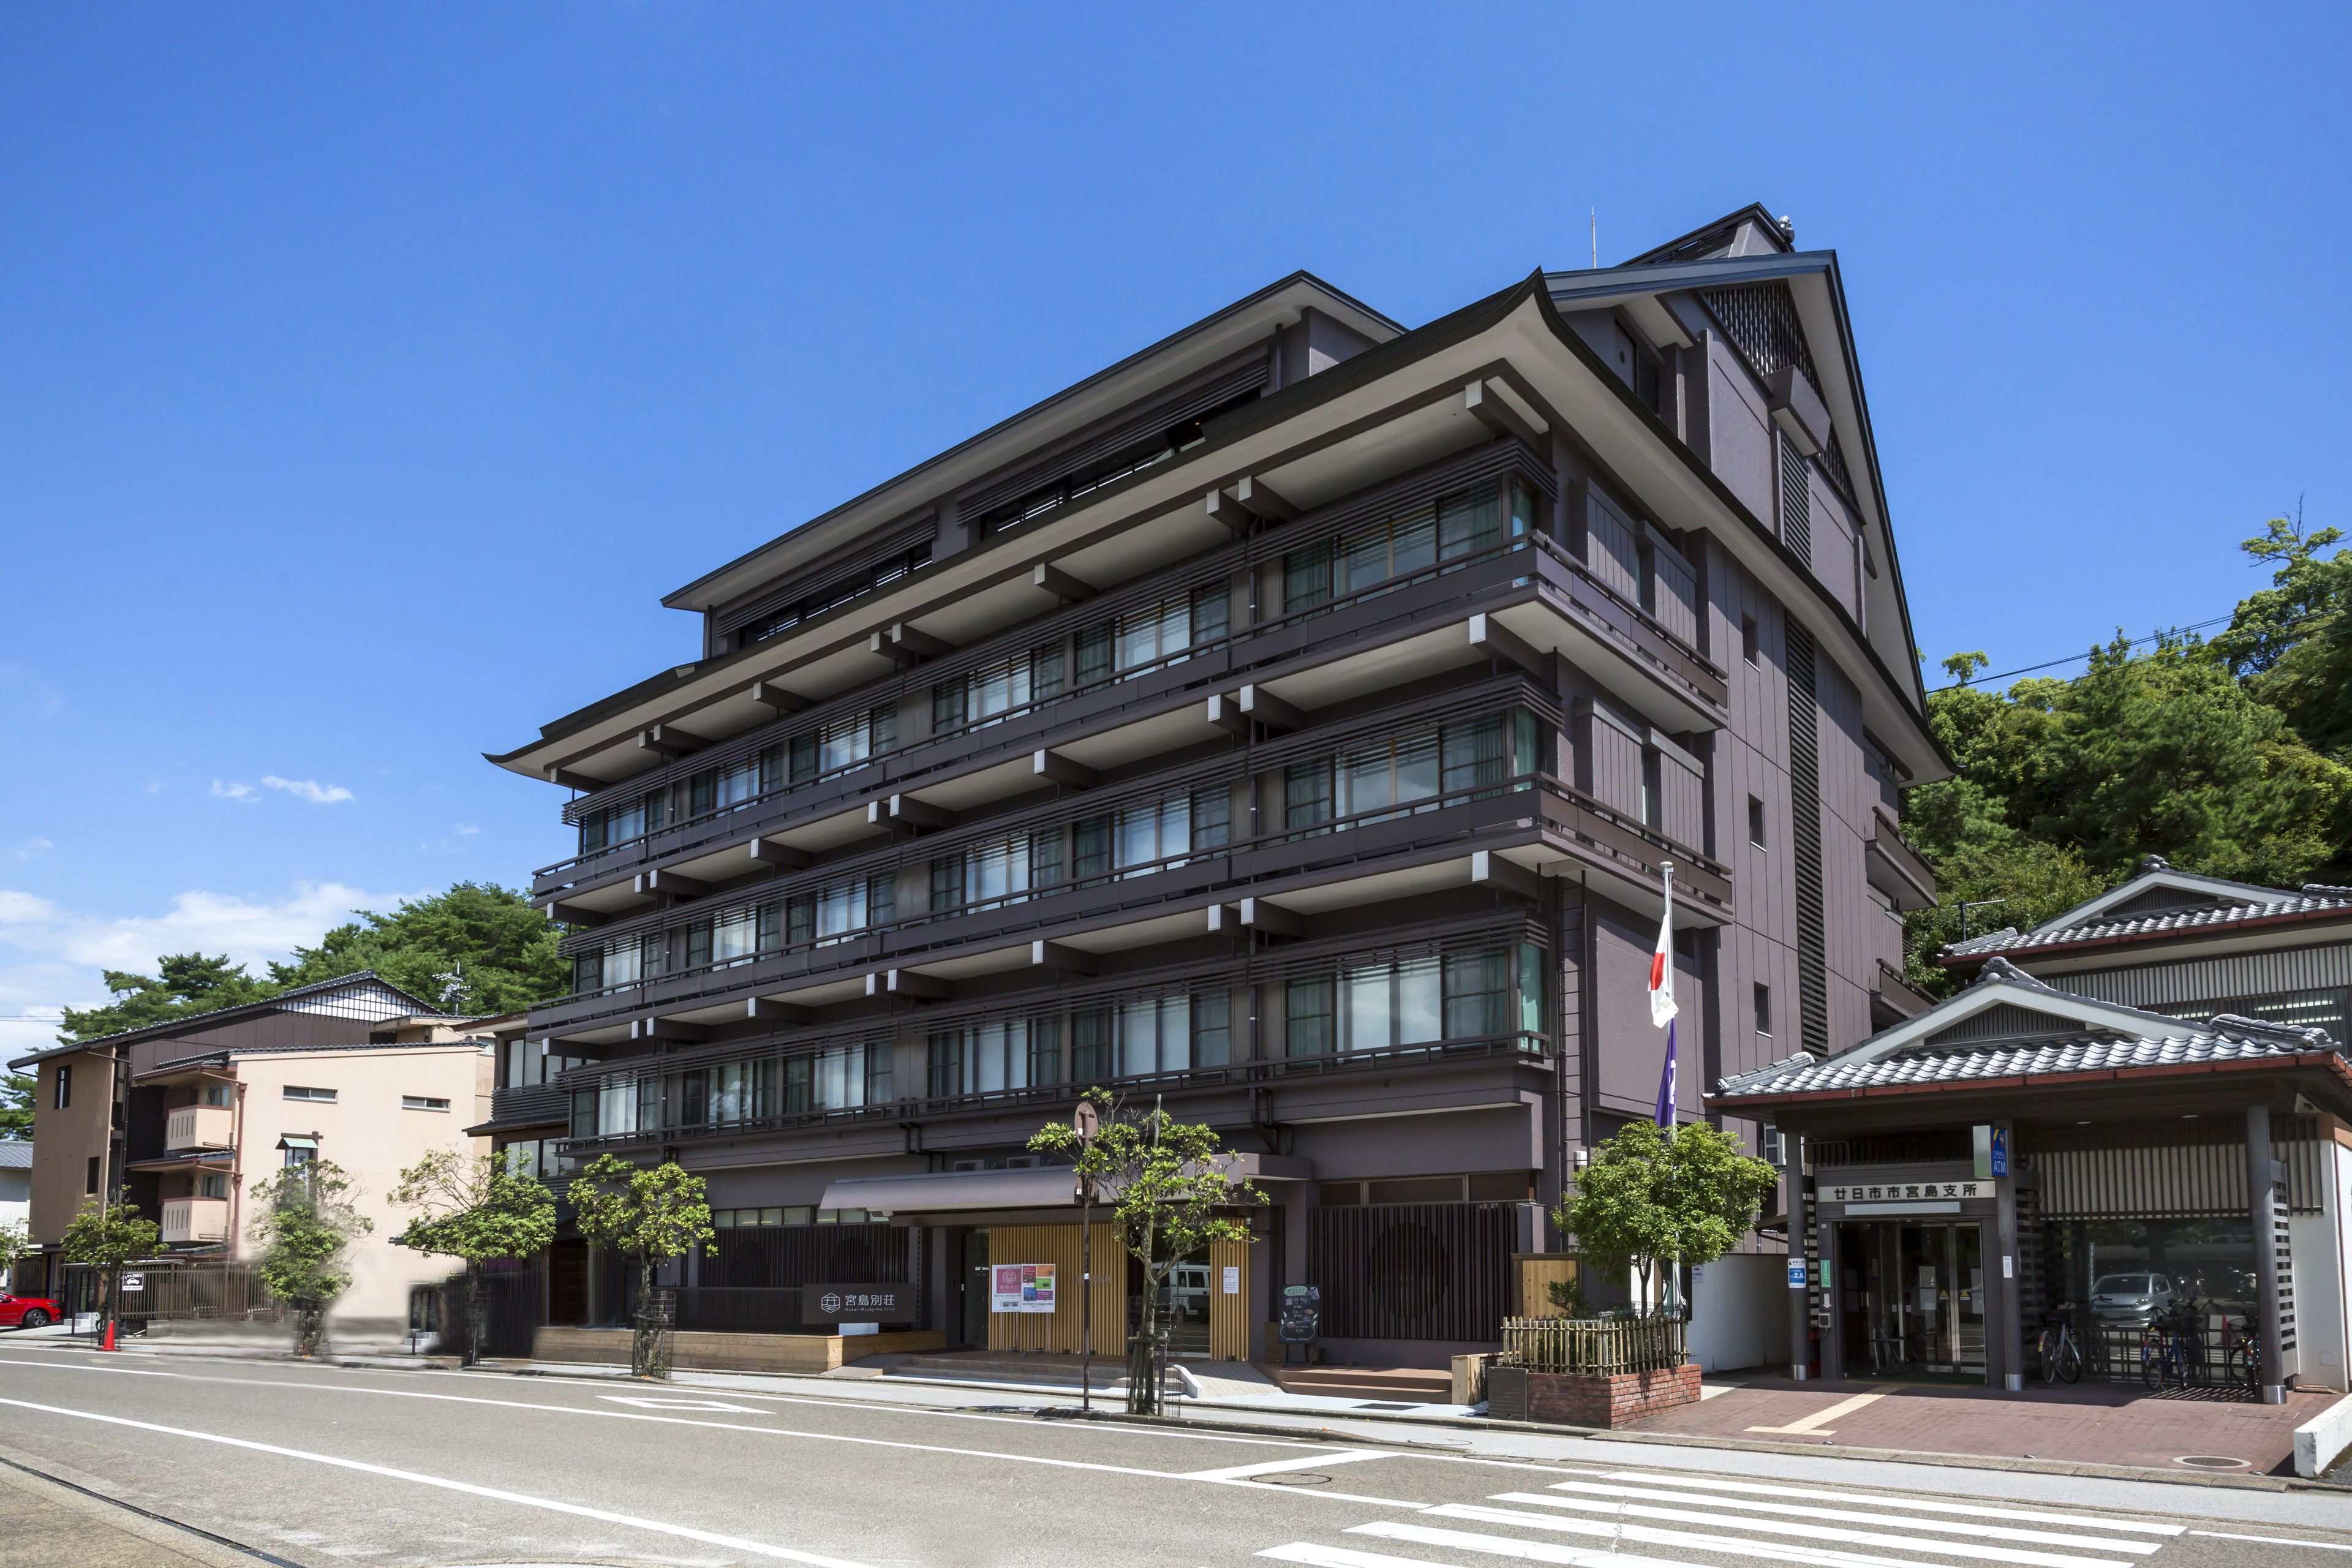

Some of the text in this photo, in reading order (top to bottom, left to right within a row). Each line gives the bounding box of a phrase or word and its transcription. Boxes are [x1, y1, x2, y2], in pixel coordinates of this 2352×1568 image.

[1994, 1160, 2007, 1173] ATM
[1834, 1184, 1977, 1200] 廿日市市宮島支所
[845, 1294, 895, 1306] 宮島別荘
